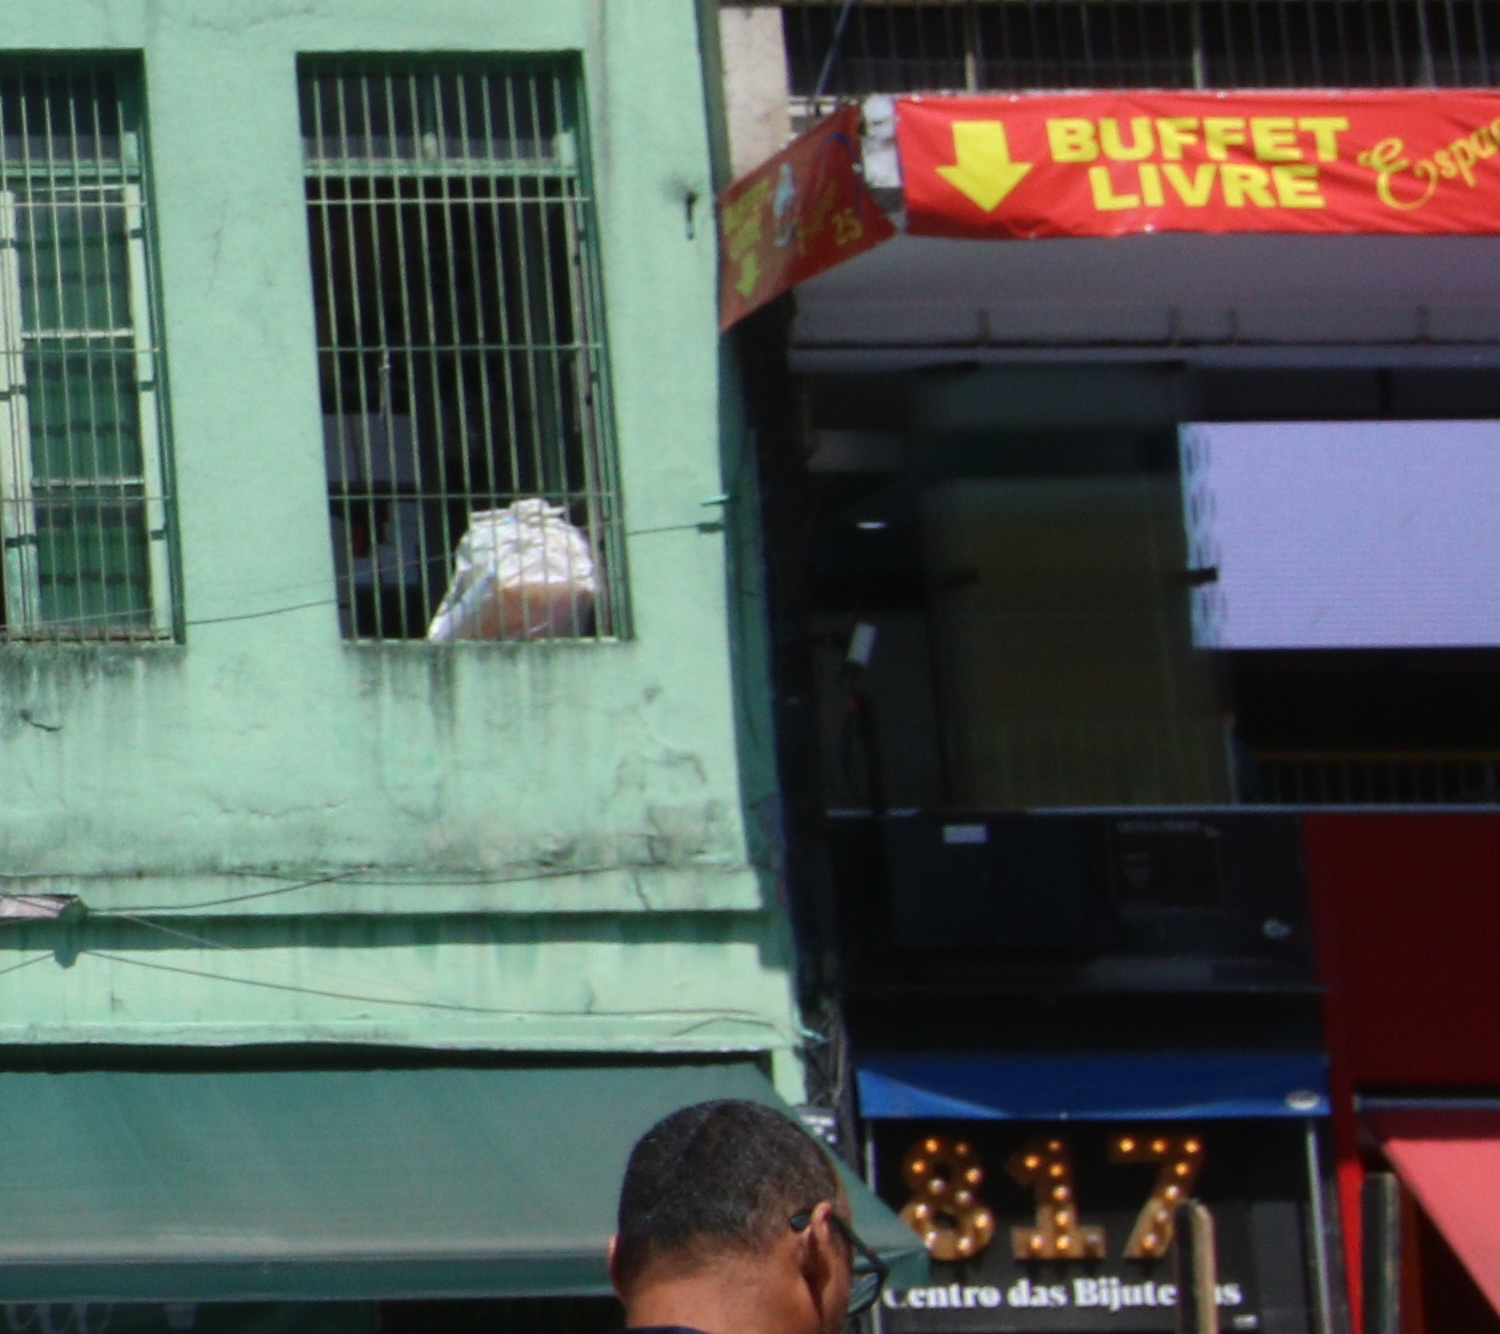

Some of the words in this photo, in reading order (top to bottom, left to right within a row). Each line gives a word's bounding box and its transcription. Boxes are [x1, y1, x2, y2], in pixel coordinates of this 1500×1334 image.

[1046, 116, 1349, 165] BUFFET
[1089, 164, 1326, 212] LIVRE
[899, 1136, 1205, 1260] 817
[883, 1281, 1002, 1309] Centro
[1008, 1278, 1067, 1308] das
[1073, 1277, 1242, 1313] Bijutes
